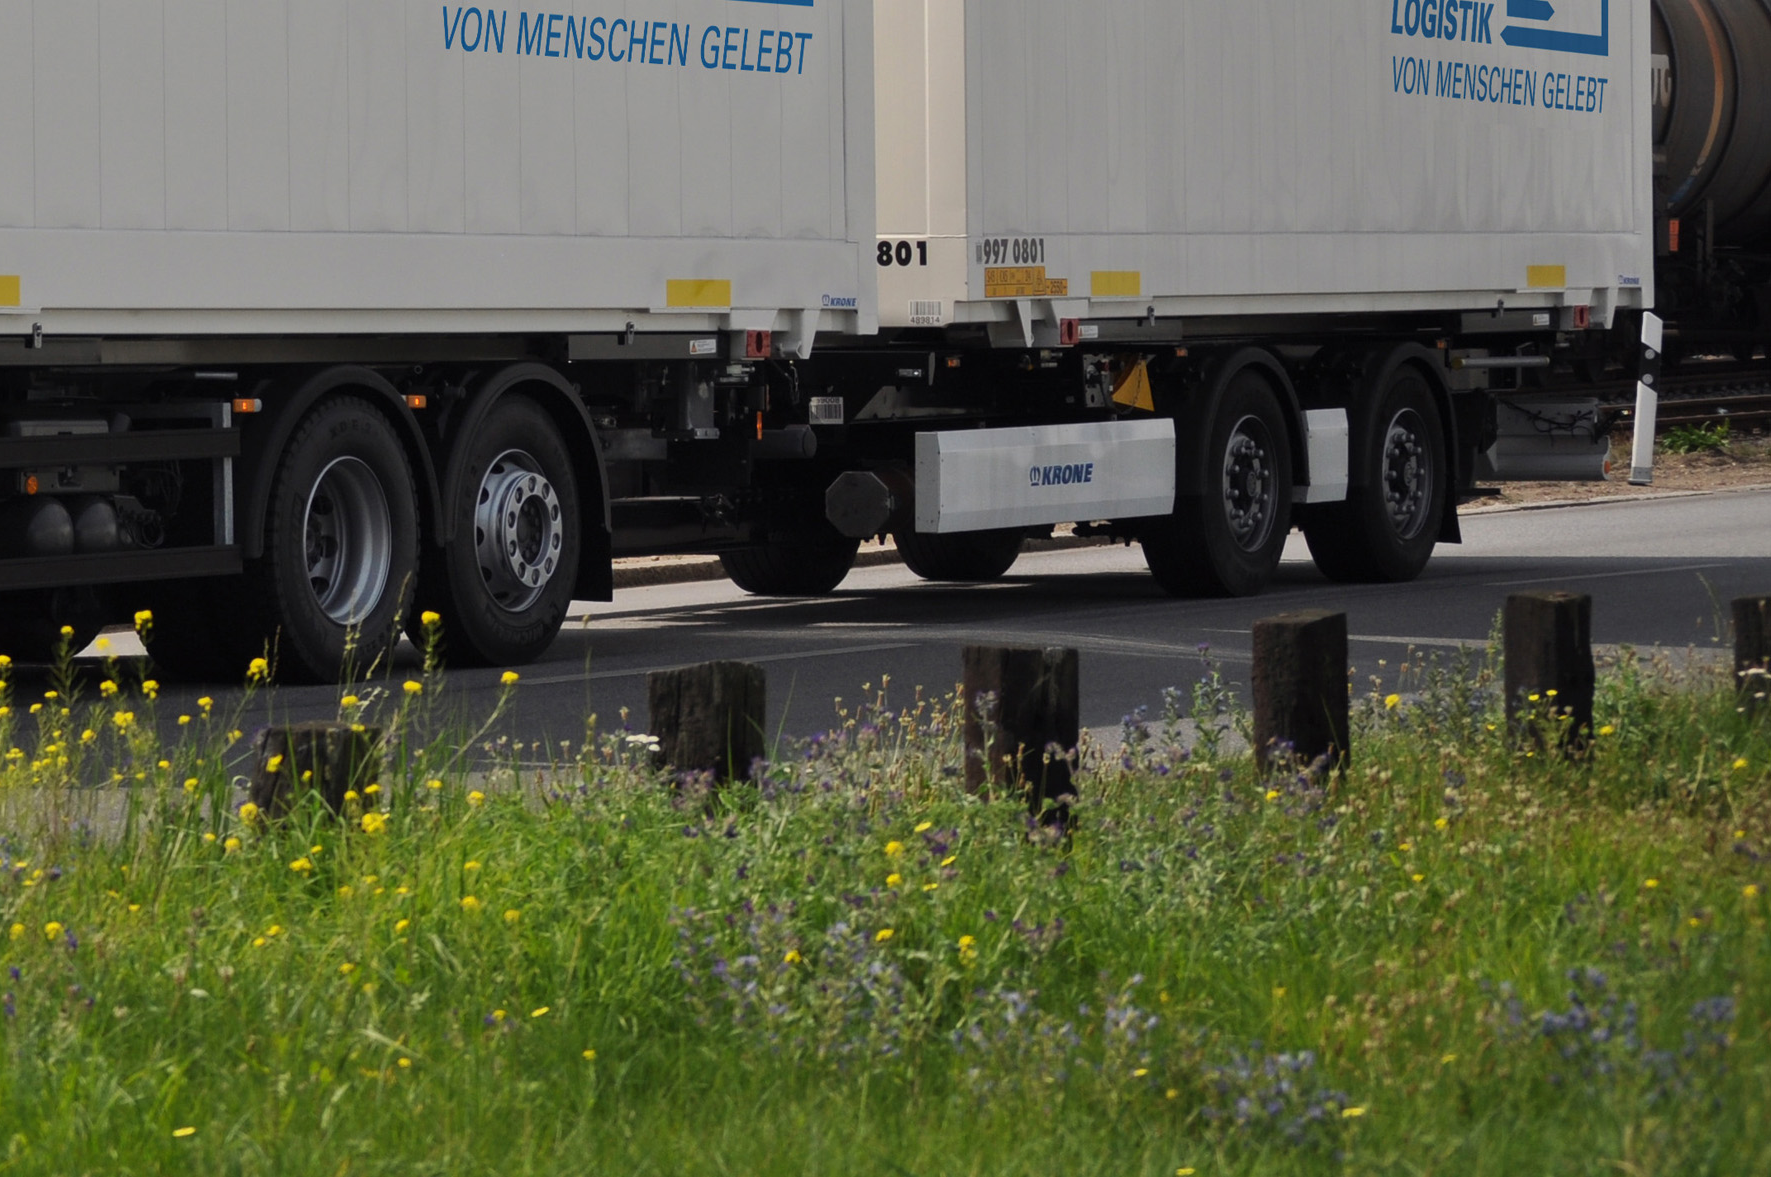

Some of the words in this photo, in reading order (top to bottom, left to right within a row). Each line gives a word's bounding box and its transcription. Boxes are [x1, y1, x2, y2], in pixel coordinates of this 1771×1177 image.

[442, 6, 507, 54] VON
[516, 11, 690, 67] MENSCHEN
[700, 25, 813, 75] GELEBT
[1393, 56, 1430, 96] VON
[1436, 60, 1537, 106] MENSCHEN
[1542, 72, 1608, 114] GELEBT
[983, 238, 1008, 264] 997
[1013, 238, 1045, 264] 0801
[830, 297, 857, 307] KRONE
[910, 316, 941, 324] 489814
[1041, 462, 1094, 485] KRONE
